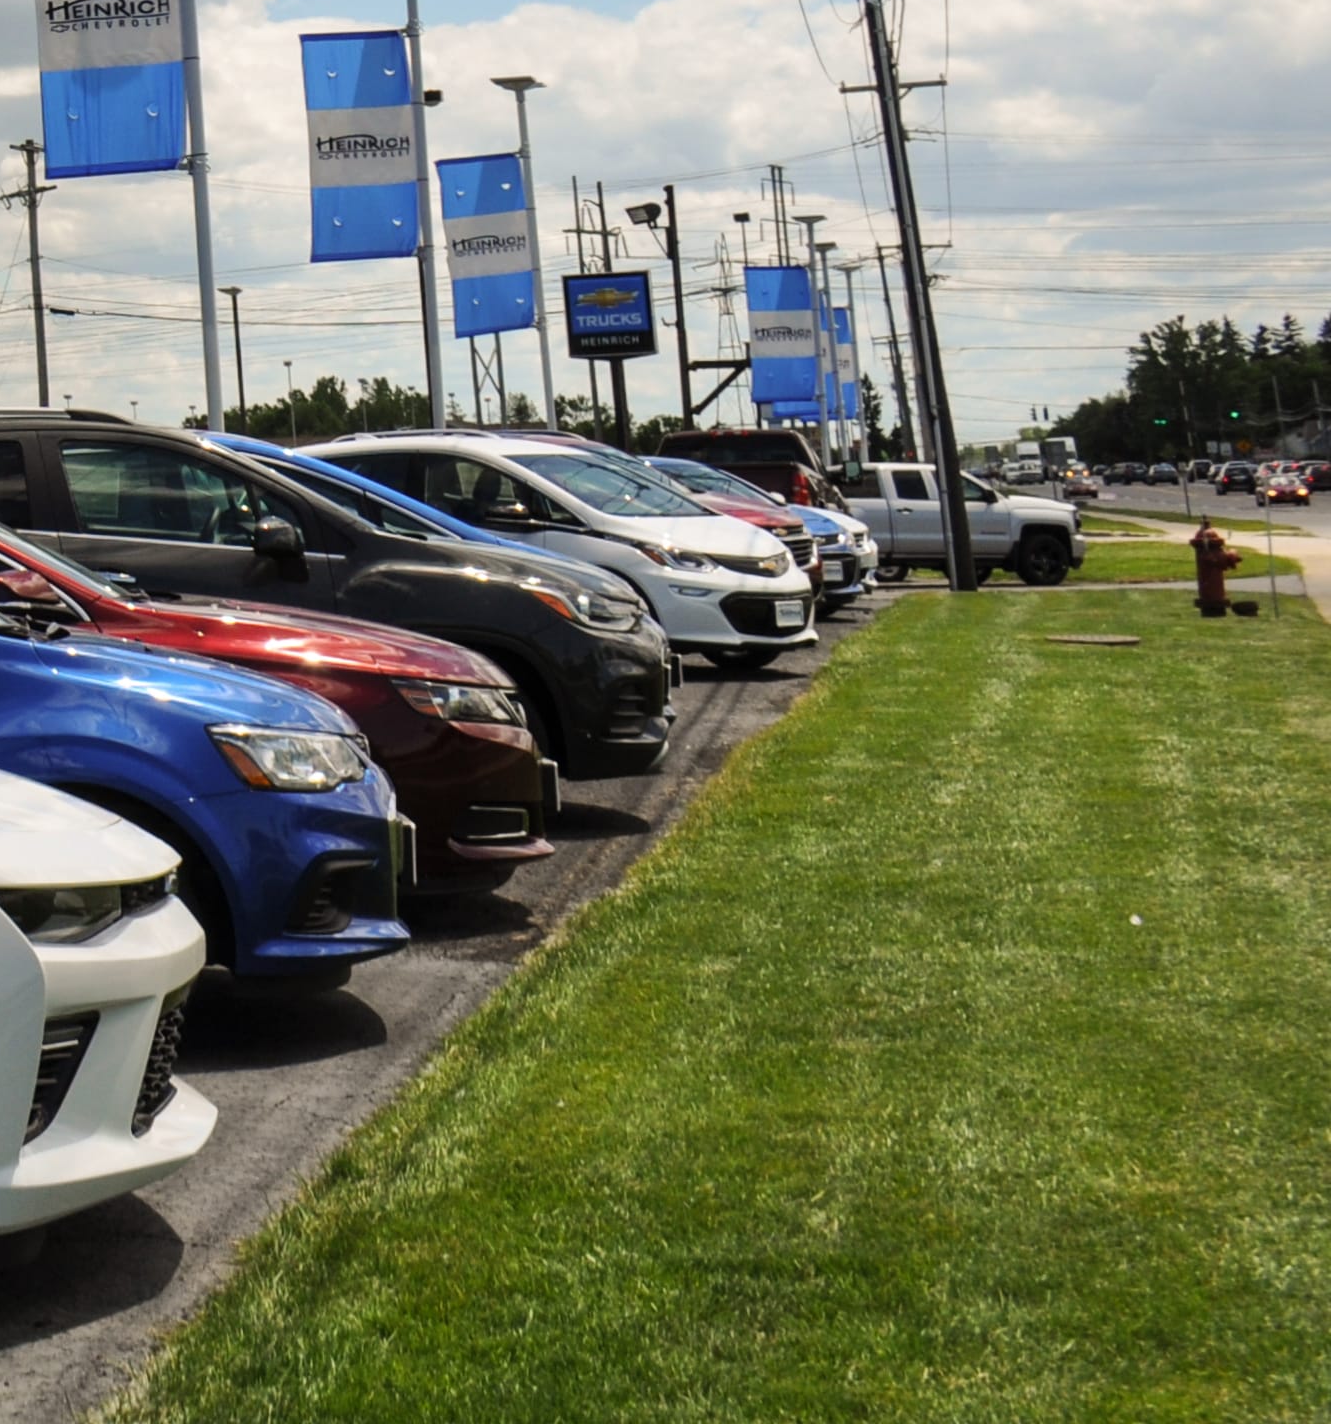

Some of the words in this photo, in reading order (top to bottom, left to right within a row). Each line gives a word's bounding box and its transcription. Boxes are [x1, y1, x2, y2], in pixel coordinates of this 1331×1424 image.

[71, 16, 171, 32] CHEVROLET
[315, 134, 410, 152] HEINRICH
[576, 313, 642, 328] TRUCKS
[580, 335, 640, 347] HEINRICH
